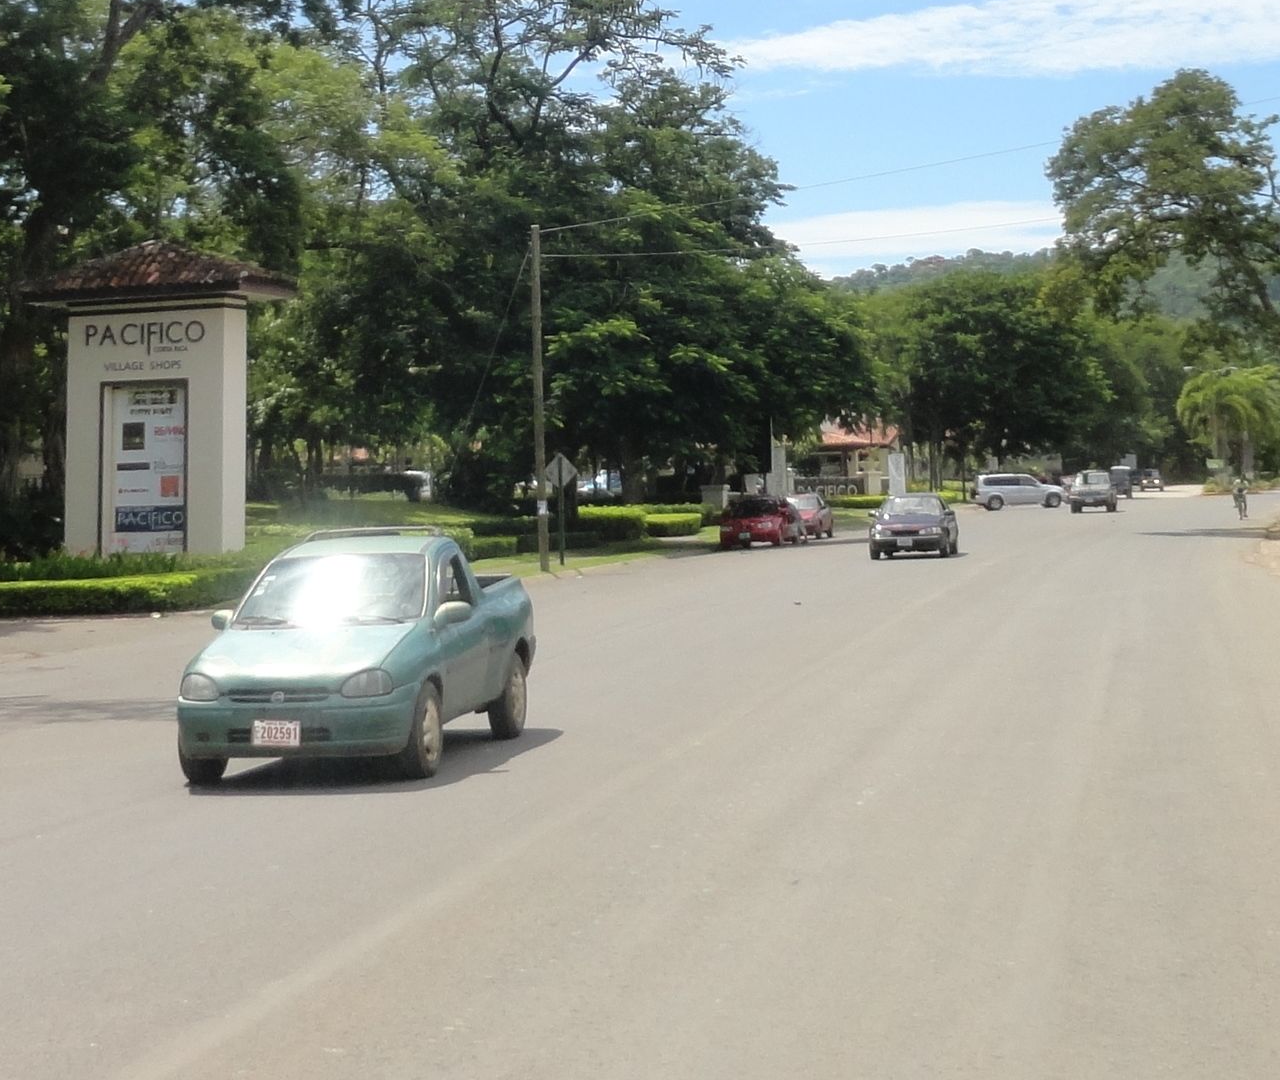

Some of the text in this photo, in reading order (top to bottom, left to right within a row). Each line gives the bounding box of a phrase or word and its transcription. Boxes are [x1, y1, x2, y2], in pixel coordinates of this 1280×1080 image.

[85, 320, 205, 356] PACIFICO
[103, 360, 182, 371] VILLAGE SHOPS
[117, 511, 183, 530] PACIFICO
[261, 726, 298, 740] 202591
